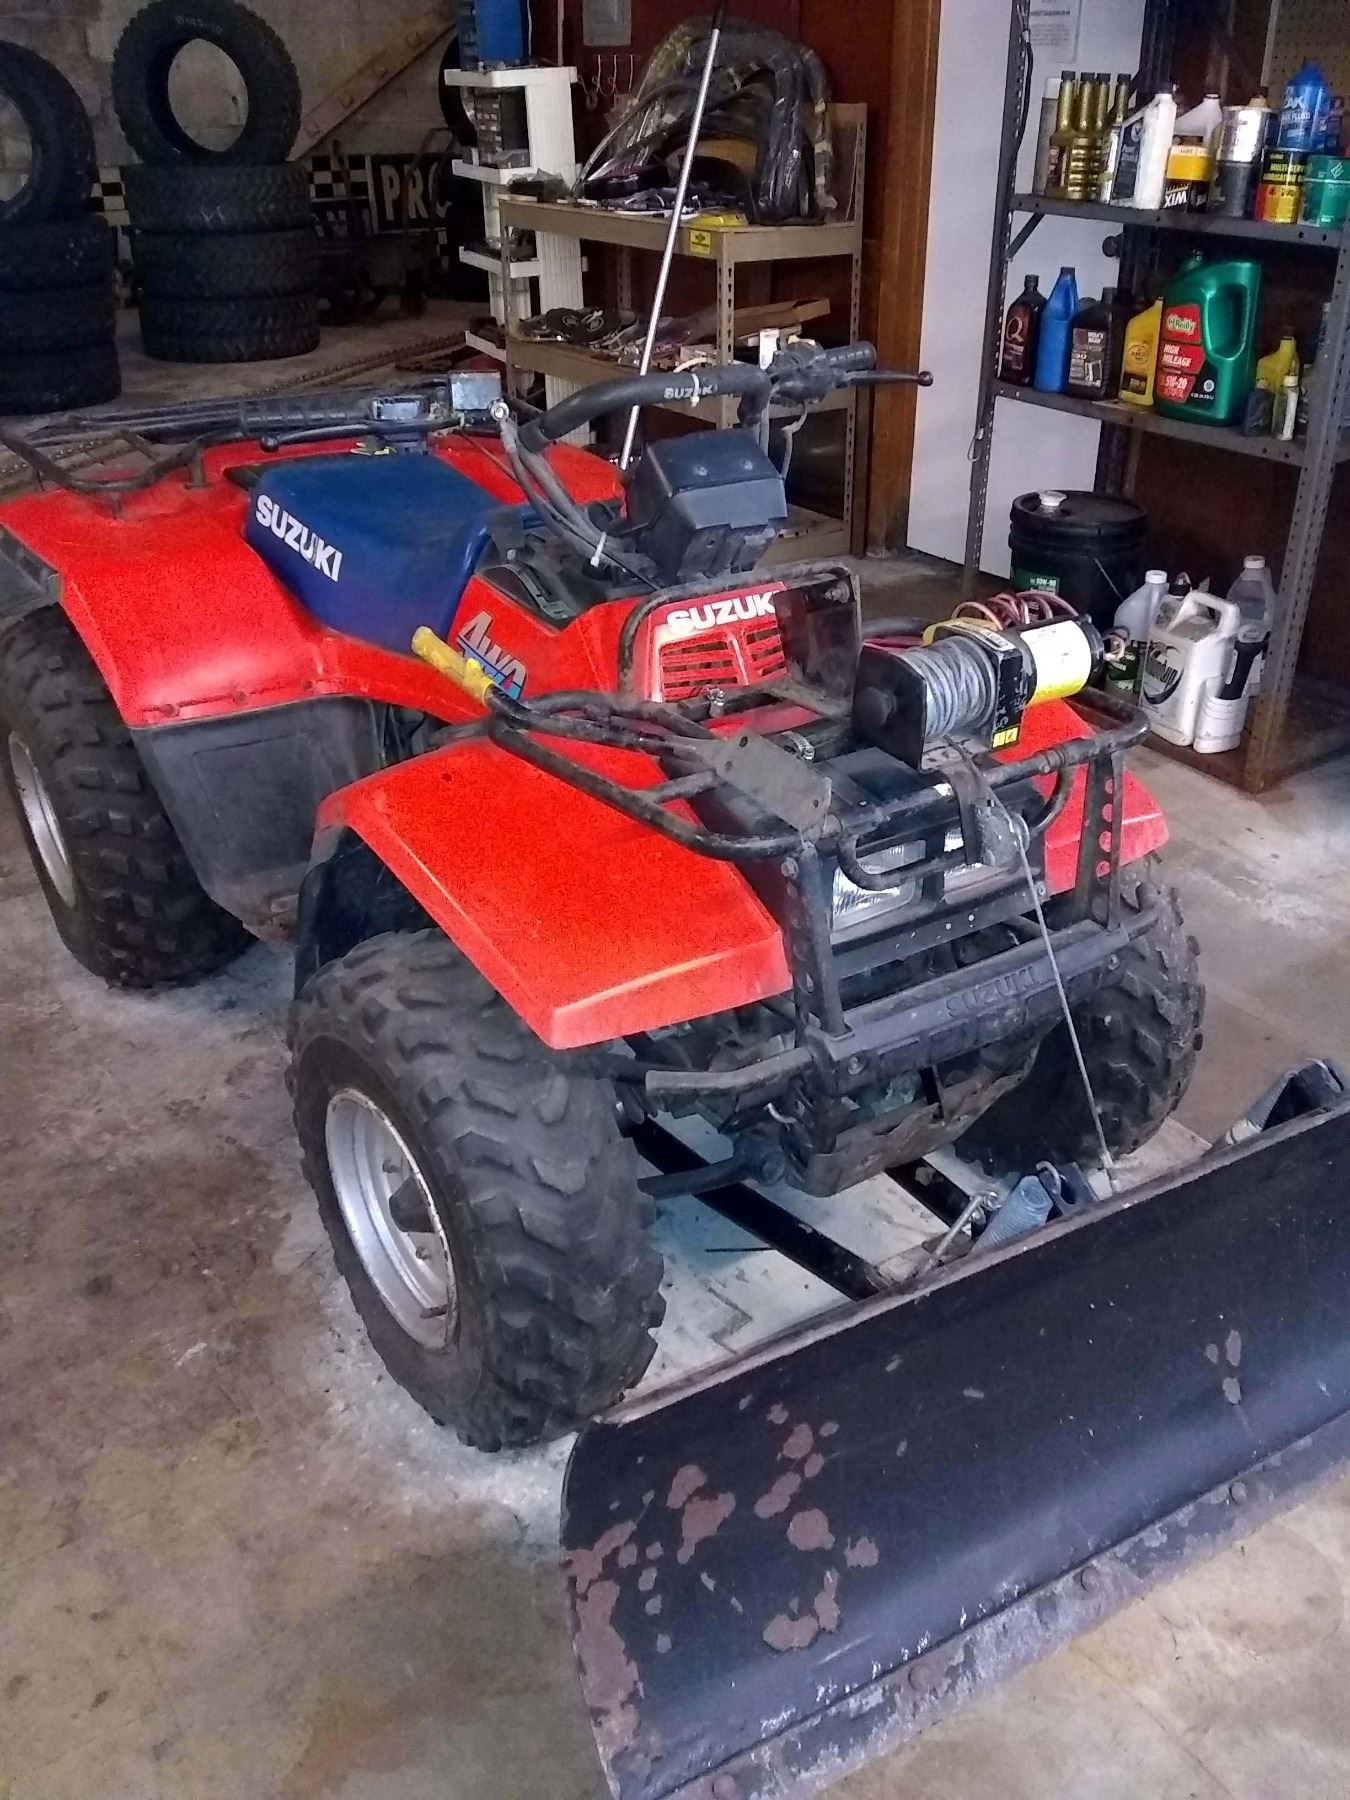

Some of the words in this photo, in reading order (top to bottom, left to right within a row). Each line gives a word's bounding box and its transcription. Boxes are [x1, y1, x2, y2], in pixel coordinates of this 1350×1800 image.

[1162, 354, 1192, 367] MILEAGE
[664, 383, 719, 399] SUZKI
[255, 494, 343, 582] SUZUKI
[666, 589, 780, 633] SUZUK
[945, 964, 1036, 1018] SUZUKI
